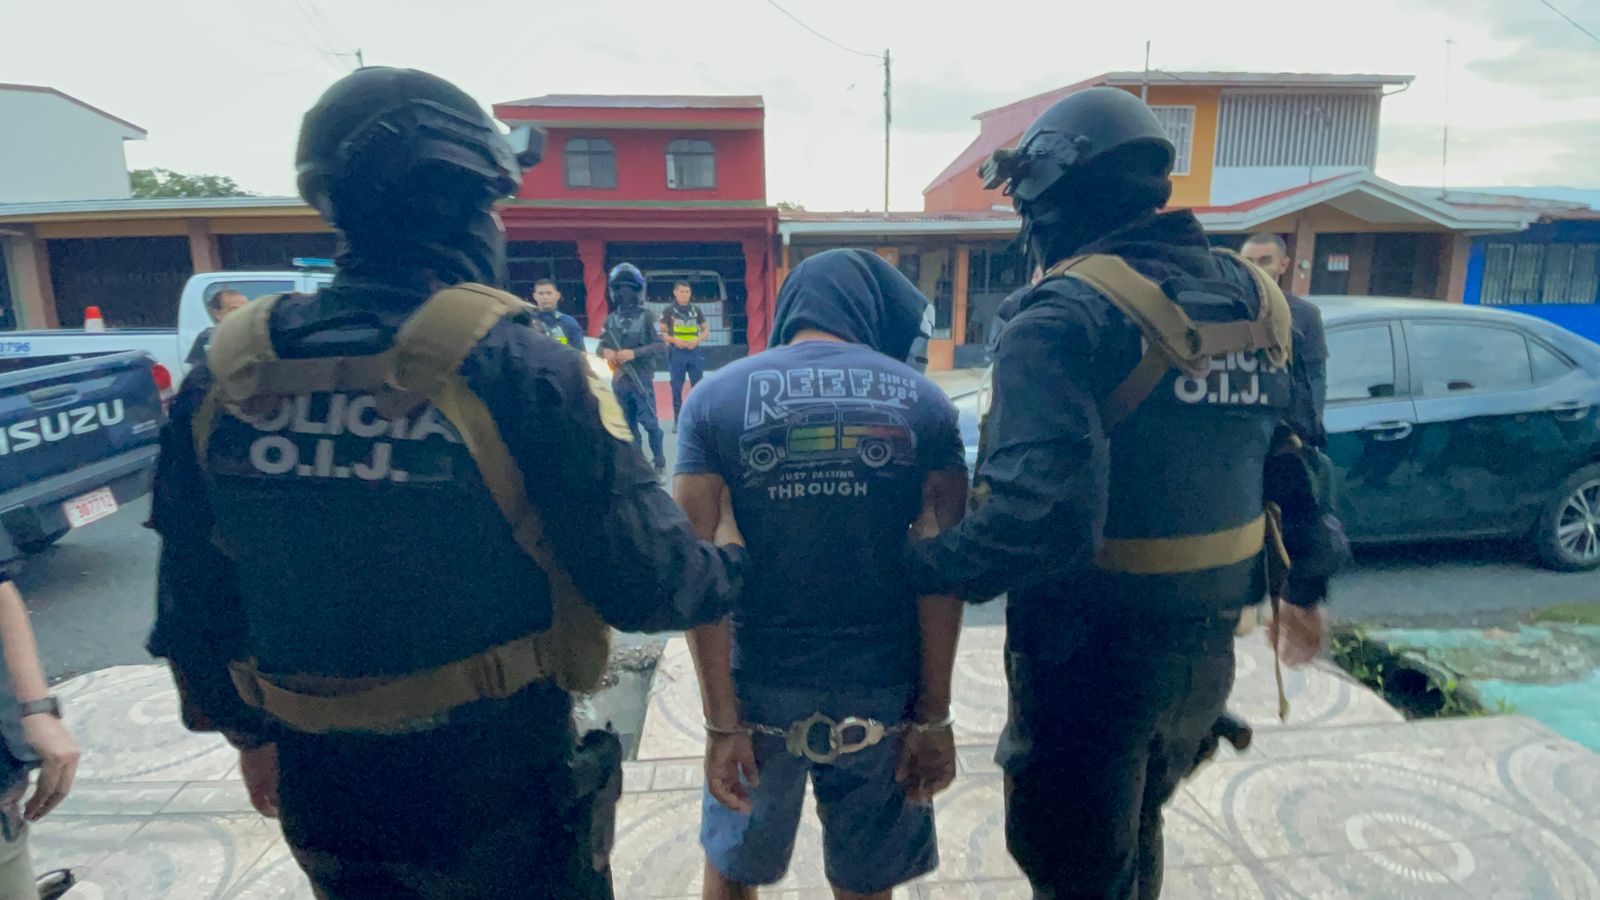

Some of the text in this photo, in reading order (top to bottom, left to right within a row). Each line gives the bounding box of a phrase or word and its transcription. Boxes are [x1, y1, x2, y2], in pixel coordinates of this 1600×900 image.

[878, 372, 918, 390] SINCE
[878, 383, 919, 403] 1984
[1174, 372, 1268, 405] O.I.J.
[743, 367, 874, 431] REEF
[0, 398, 125, 456] ISUZU
[250, 435, 409, 482] O.I.J.
[779, 471, 807, 482] JUST
[767, 482, 869, 500] THROUGH
